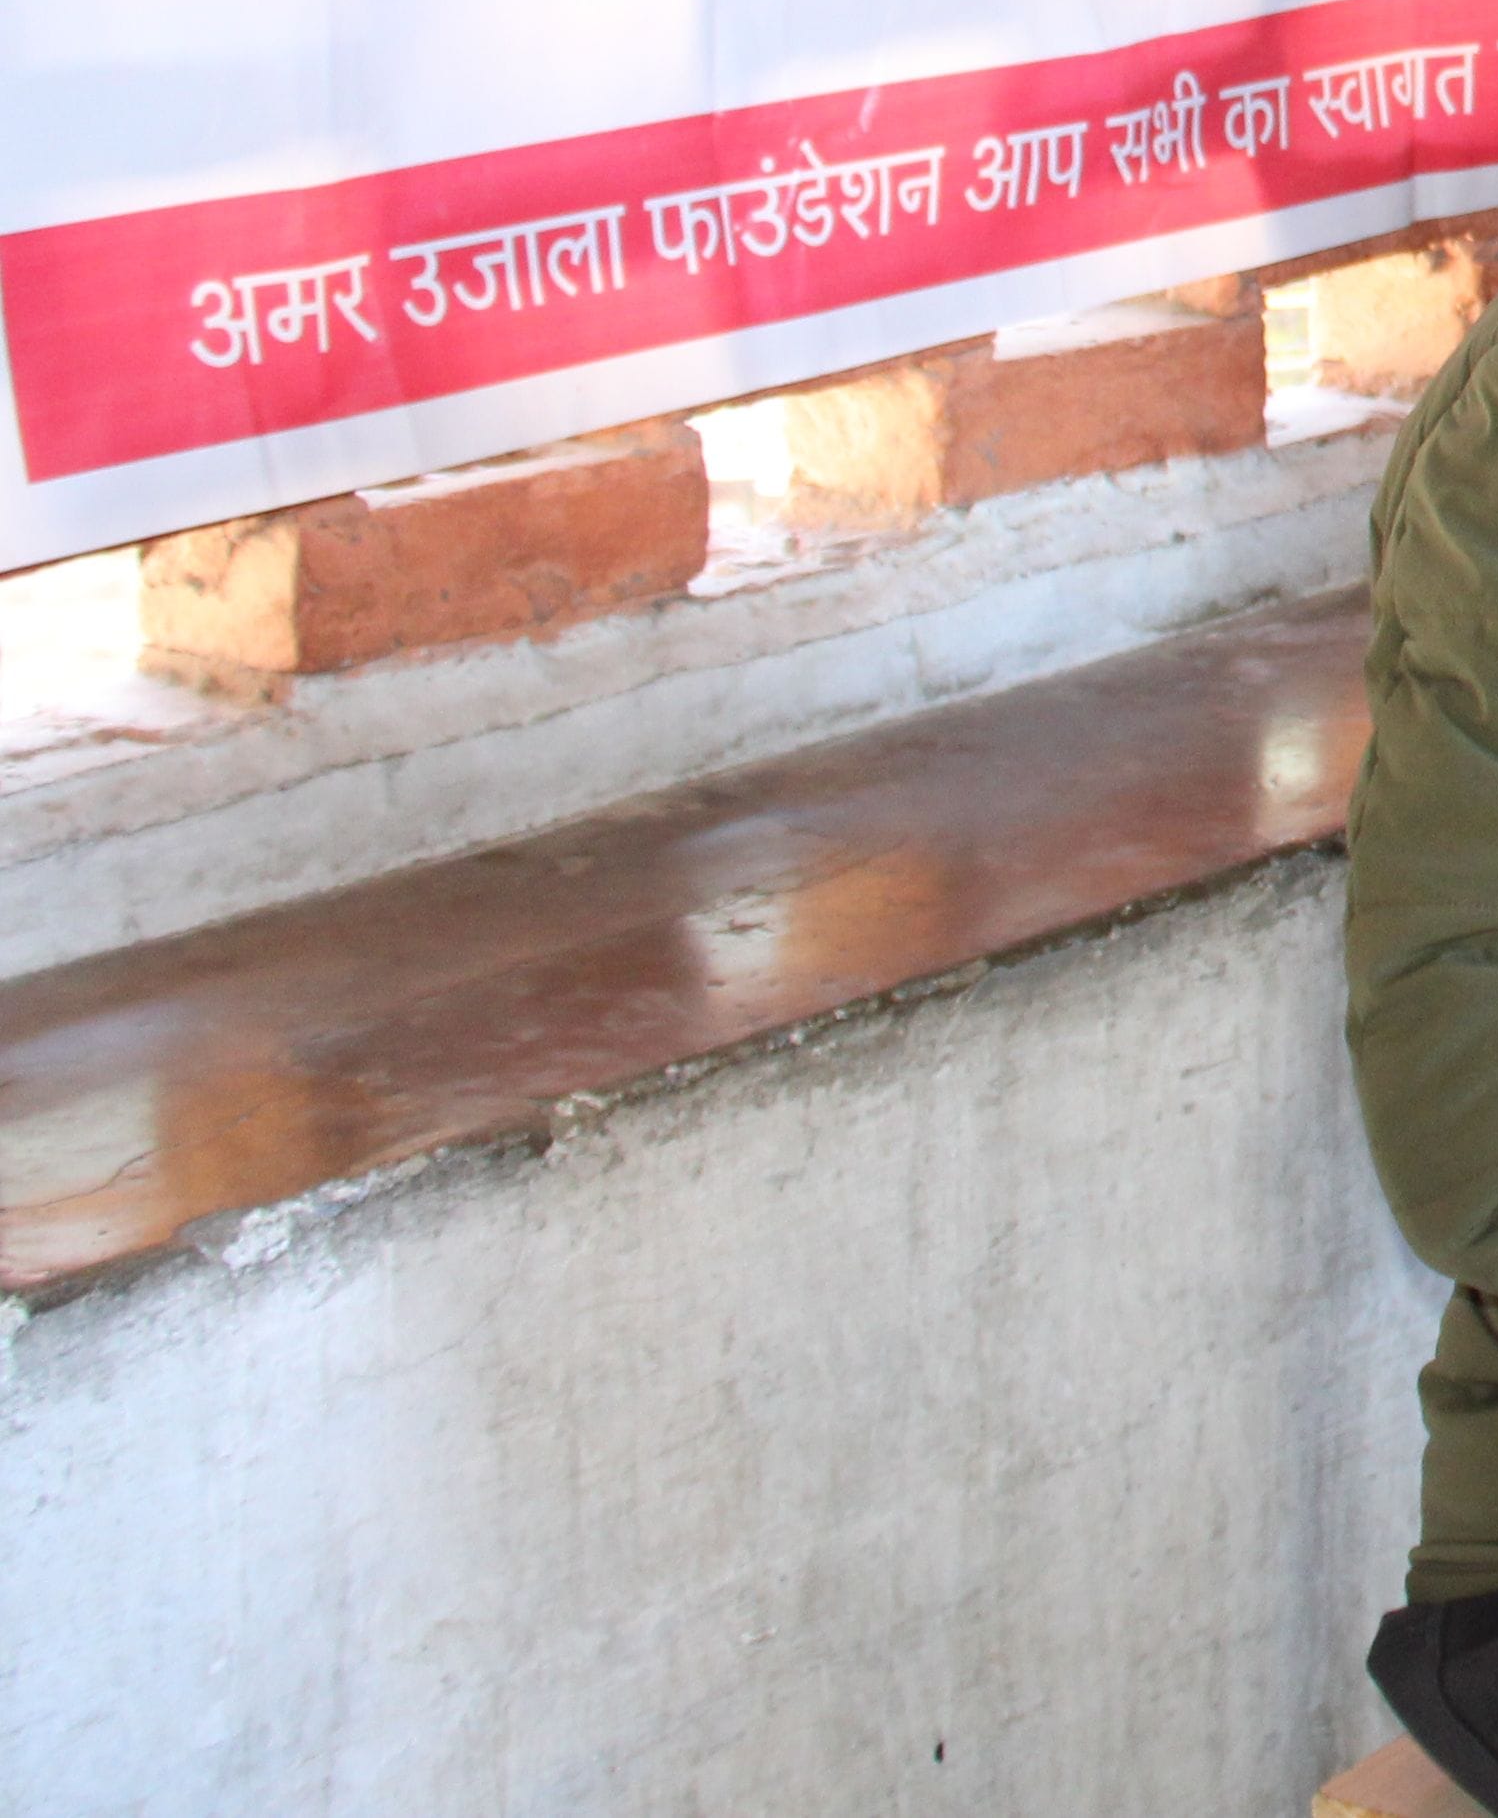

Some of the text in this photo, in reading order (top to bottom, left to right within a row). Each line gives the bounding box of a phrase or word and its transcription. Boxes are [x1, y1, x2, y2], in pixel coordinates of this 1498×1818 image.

[188, 253, 379, 370] अमर
[389, 203, 627, 328] उजाला
[645, 140, 945, 276] फाउंडेशन
[964, 121, 1087, 212] आप
[1106, 70, 1206, 185] सभी
[1219, 76, 1291, 158] का
[1304, 43, 1480, 138] स्वागत
